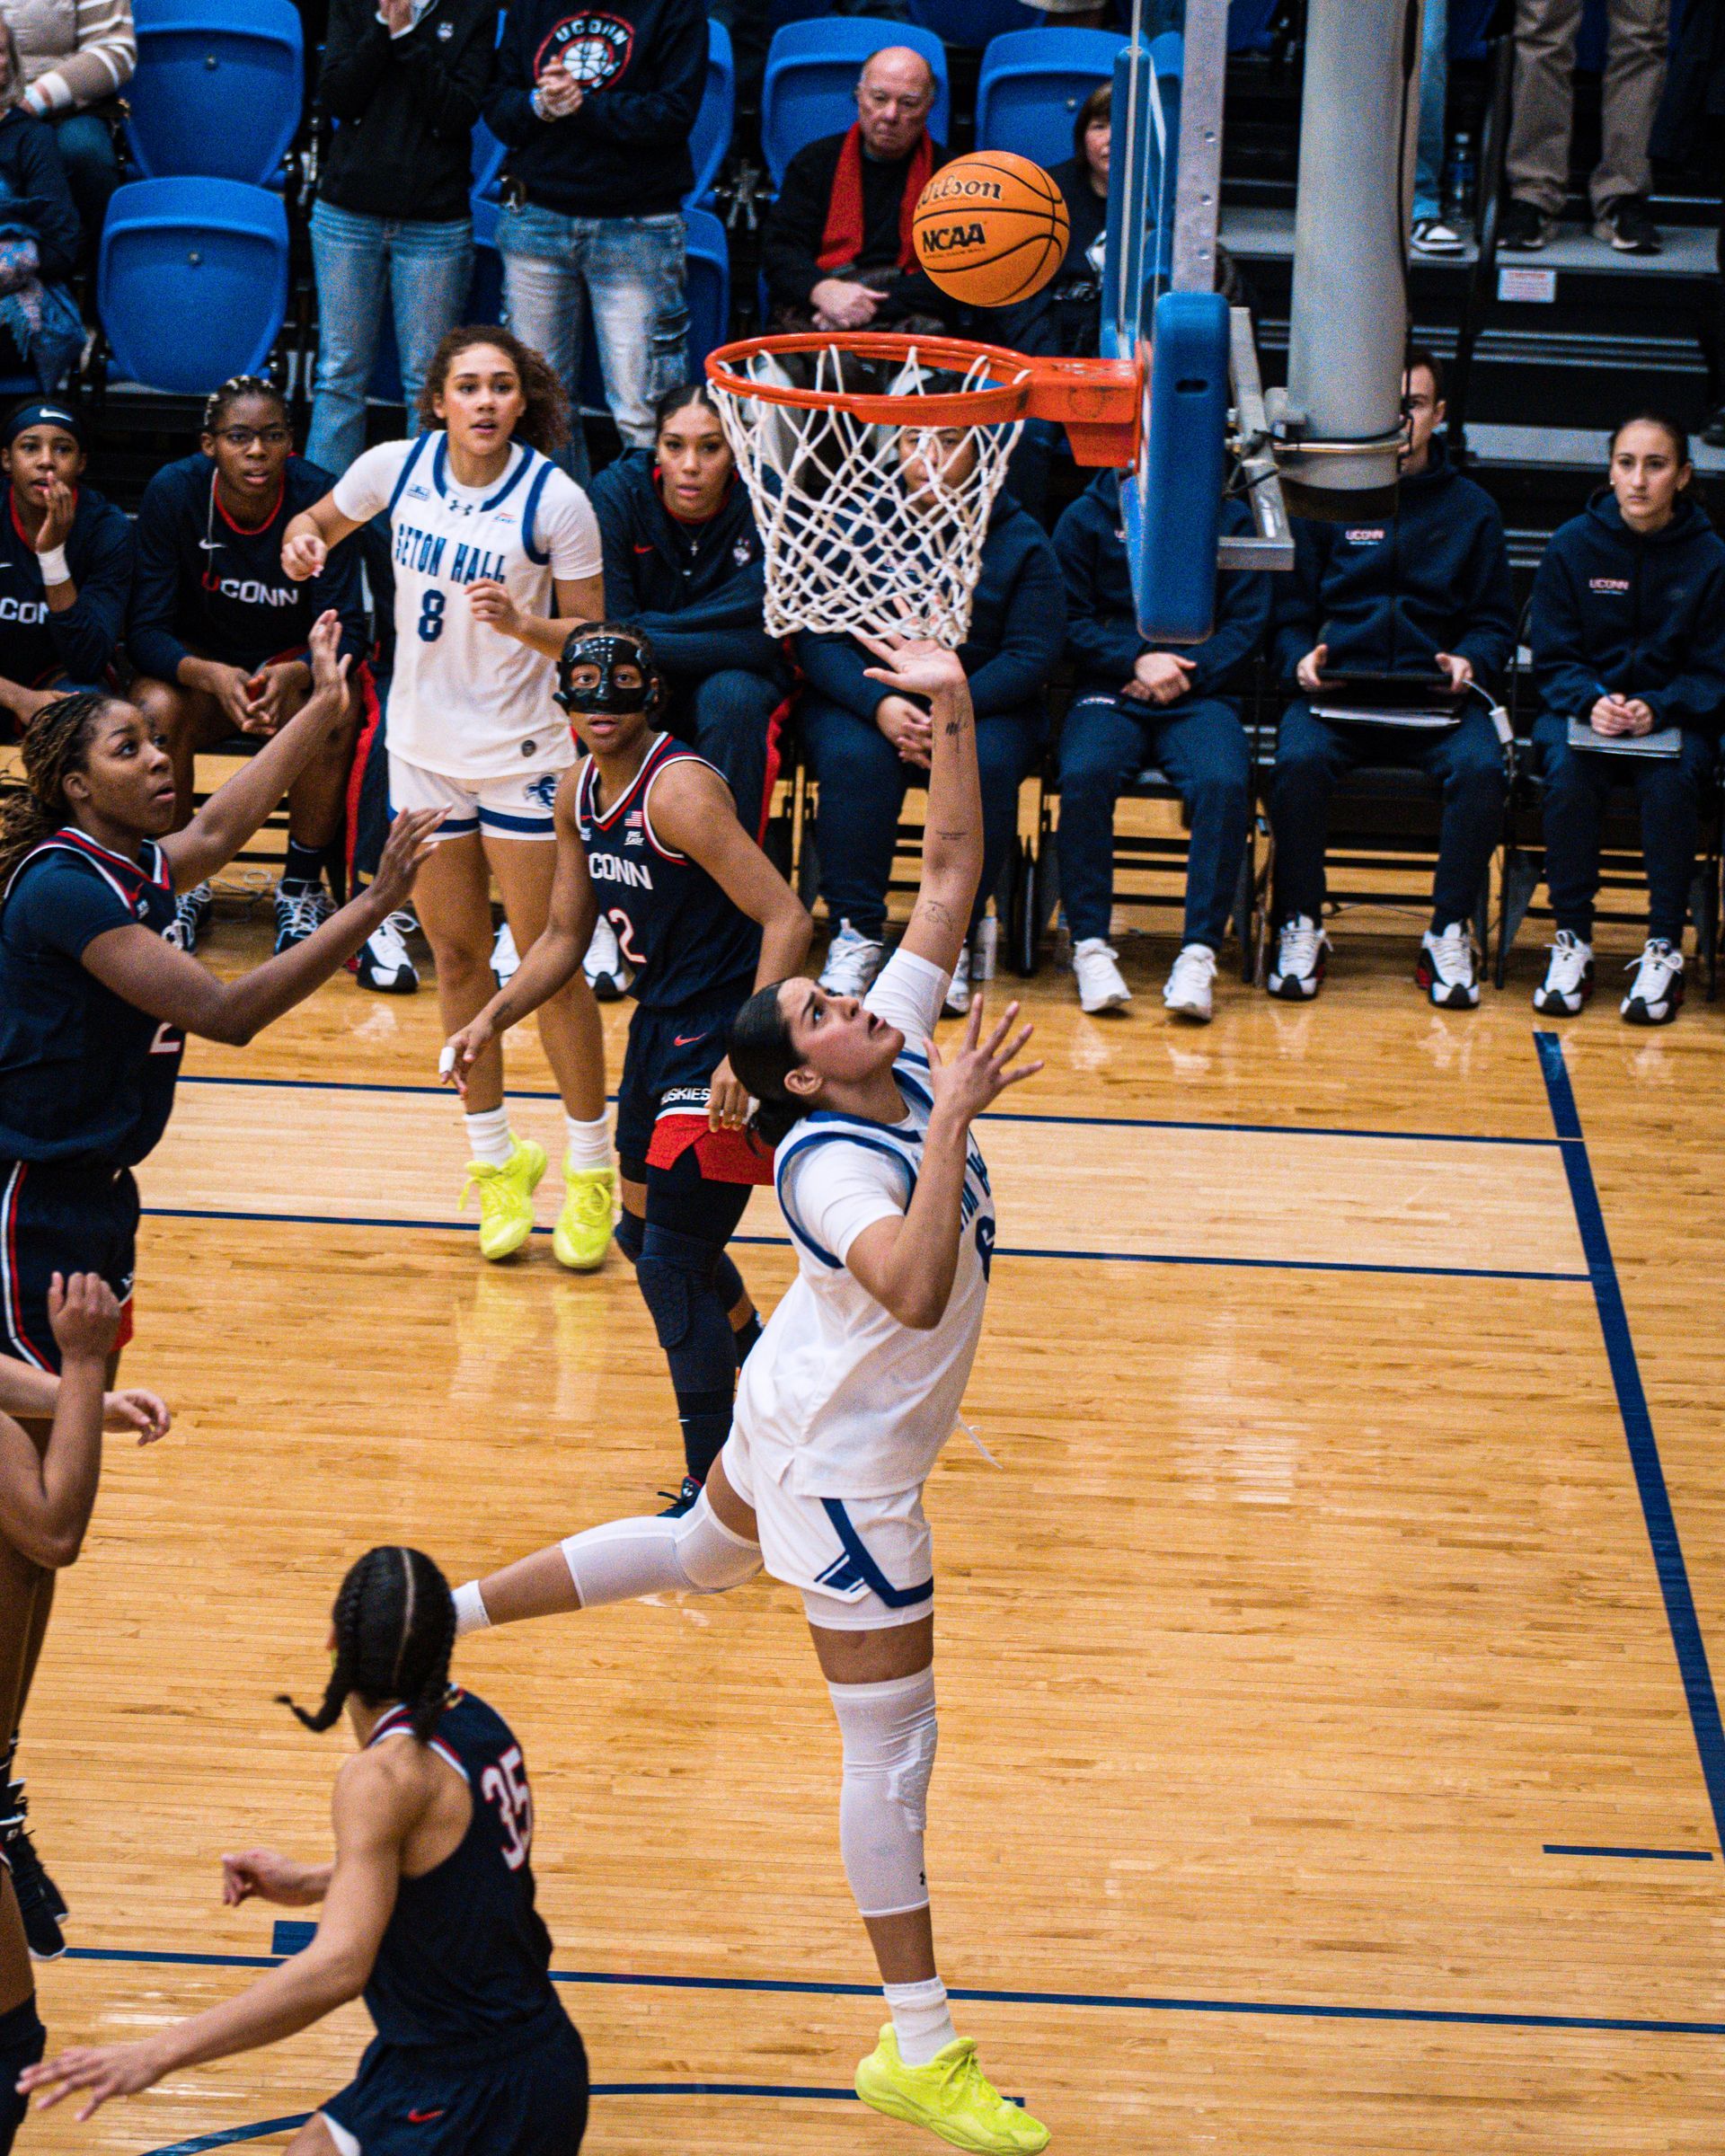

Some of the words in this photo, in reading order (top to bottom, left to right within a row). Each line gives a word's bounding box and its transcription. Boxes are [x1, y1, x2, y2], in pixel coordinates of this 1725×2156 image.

[555, 19, 630, 46] UCONN
[923, 223, 986, 253] NCAA
[451, 543, 506, 586] HALL
[201, 570, 299, 607] UCONN
[417, 588, 447, 643] 8
[480, 1745, 533, 1871] 35
